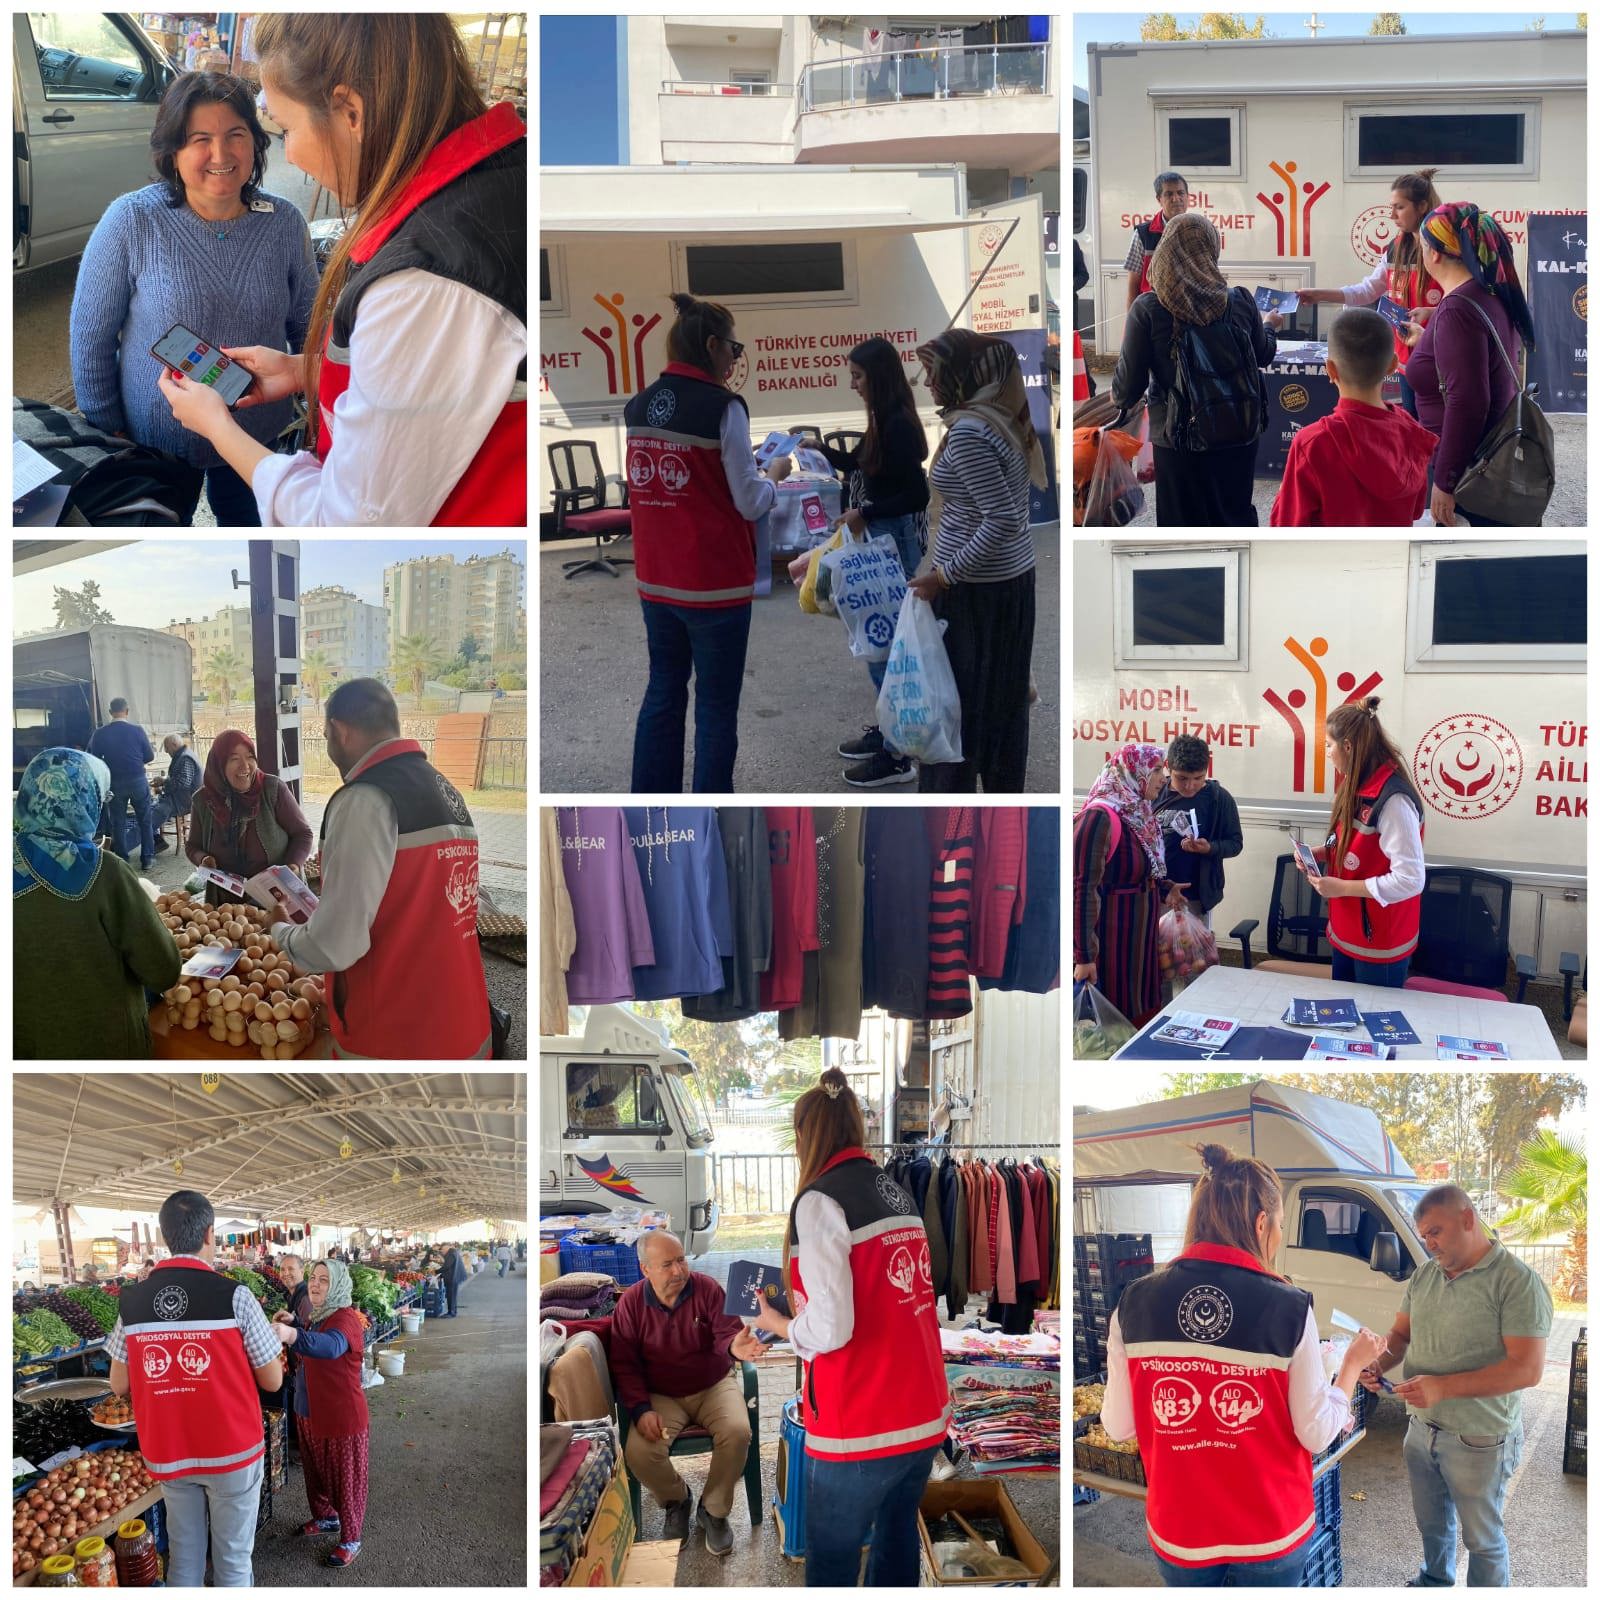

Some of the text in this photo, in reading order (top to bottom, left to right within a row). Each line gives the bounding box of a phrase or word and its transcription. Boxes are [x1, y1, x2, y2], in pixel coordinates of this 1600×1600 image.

[1188, 191, 1214, 209] BİL
[1203, 211, 1255, 230] İZMET
[980, 298, 1007, 310] MOBİL
[995, 307, 1026, 319] HİZMET
[976, 320, 1013, 332] MERKEZİ
[755, 335, 817, 352] TÜRKİYE
[756, 353, 850, 372] AİLE VE SOSY
[758, 373, 837, 392] BAKANLIĞI
[1119, 685, 1198, 713] MOBİL
[183, 1331, 212, 1341] DESTEK
[145, 1359, 166, 1372] 183
[184, 1356, 204, 1369] 144
[1141, 1358, 1218, 1376] PSİKOSOSYAL
[1158, 1387, 1177, 1400] ALO
[1222, 1388, 1241, 1401] ALO
[1154, 1398, 1191, 1418] 183
[1217, 1399, 1254, 1419] 144
[1170, 1439, 1237, 1452] www.aile.gov.tr
